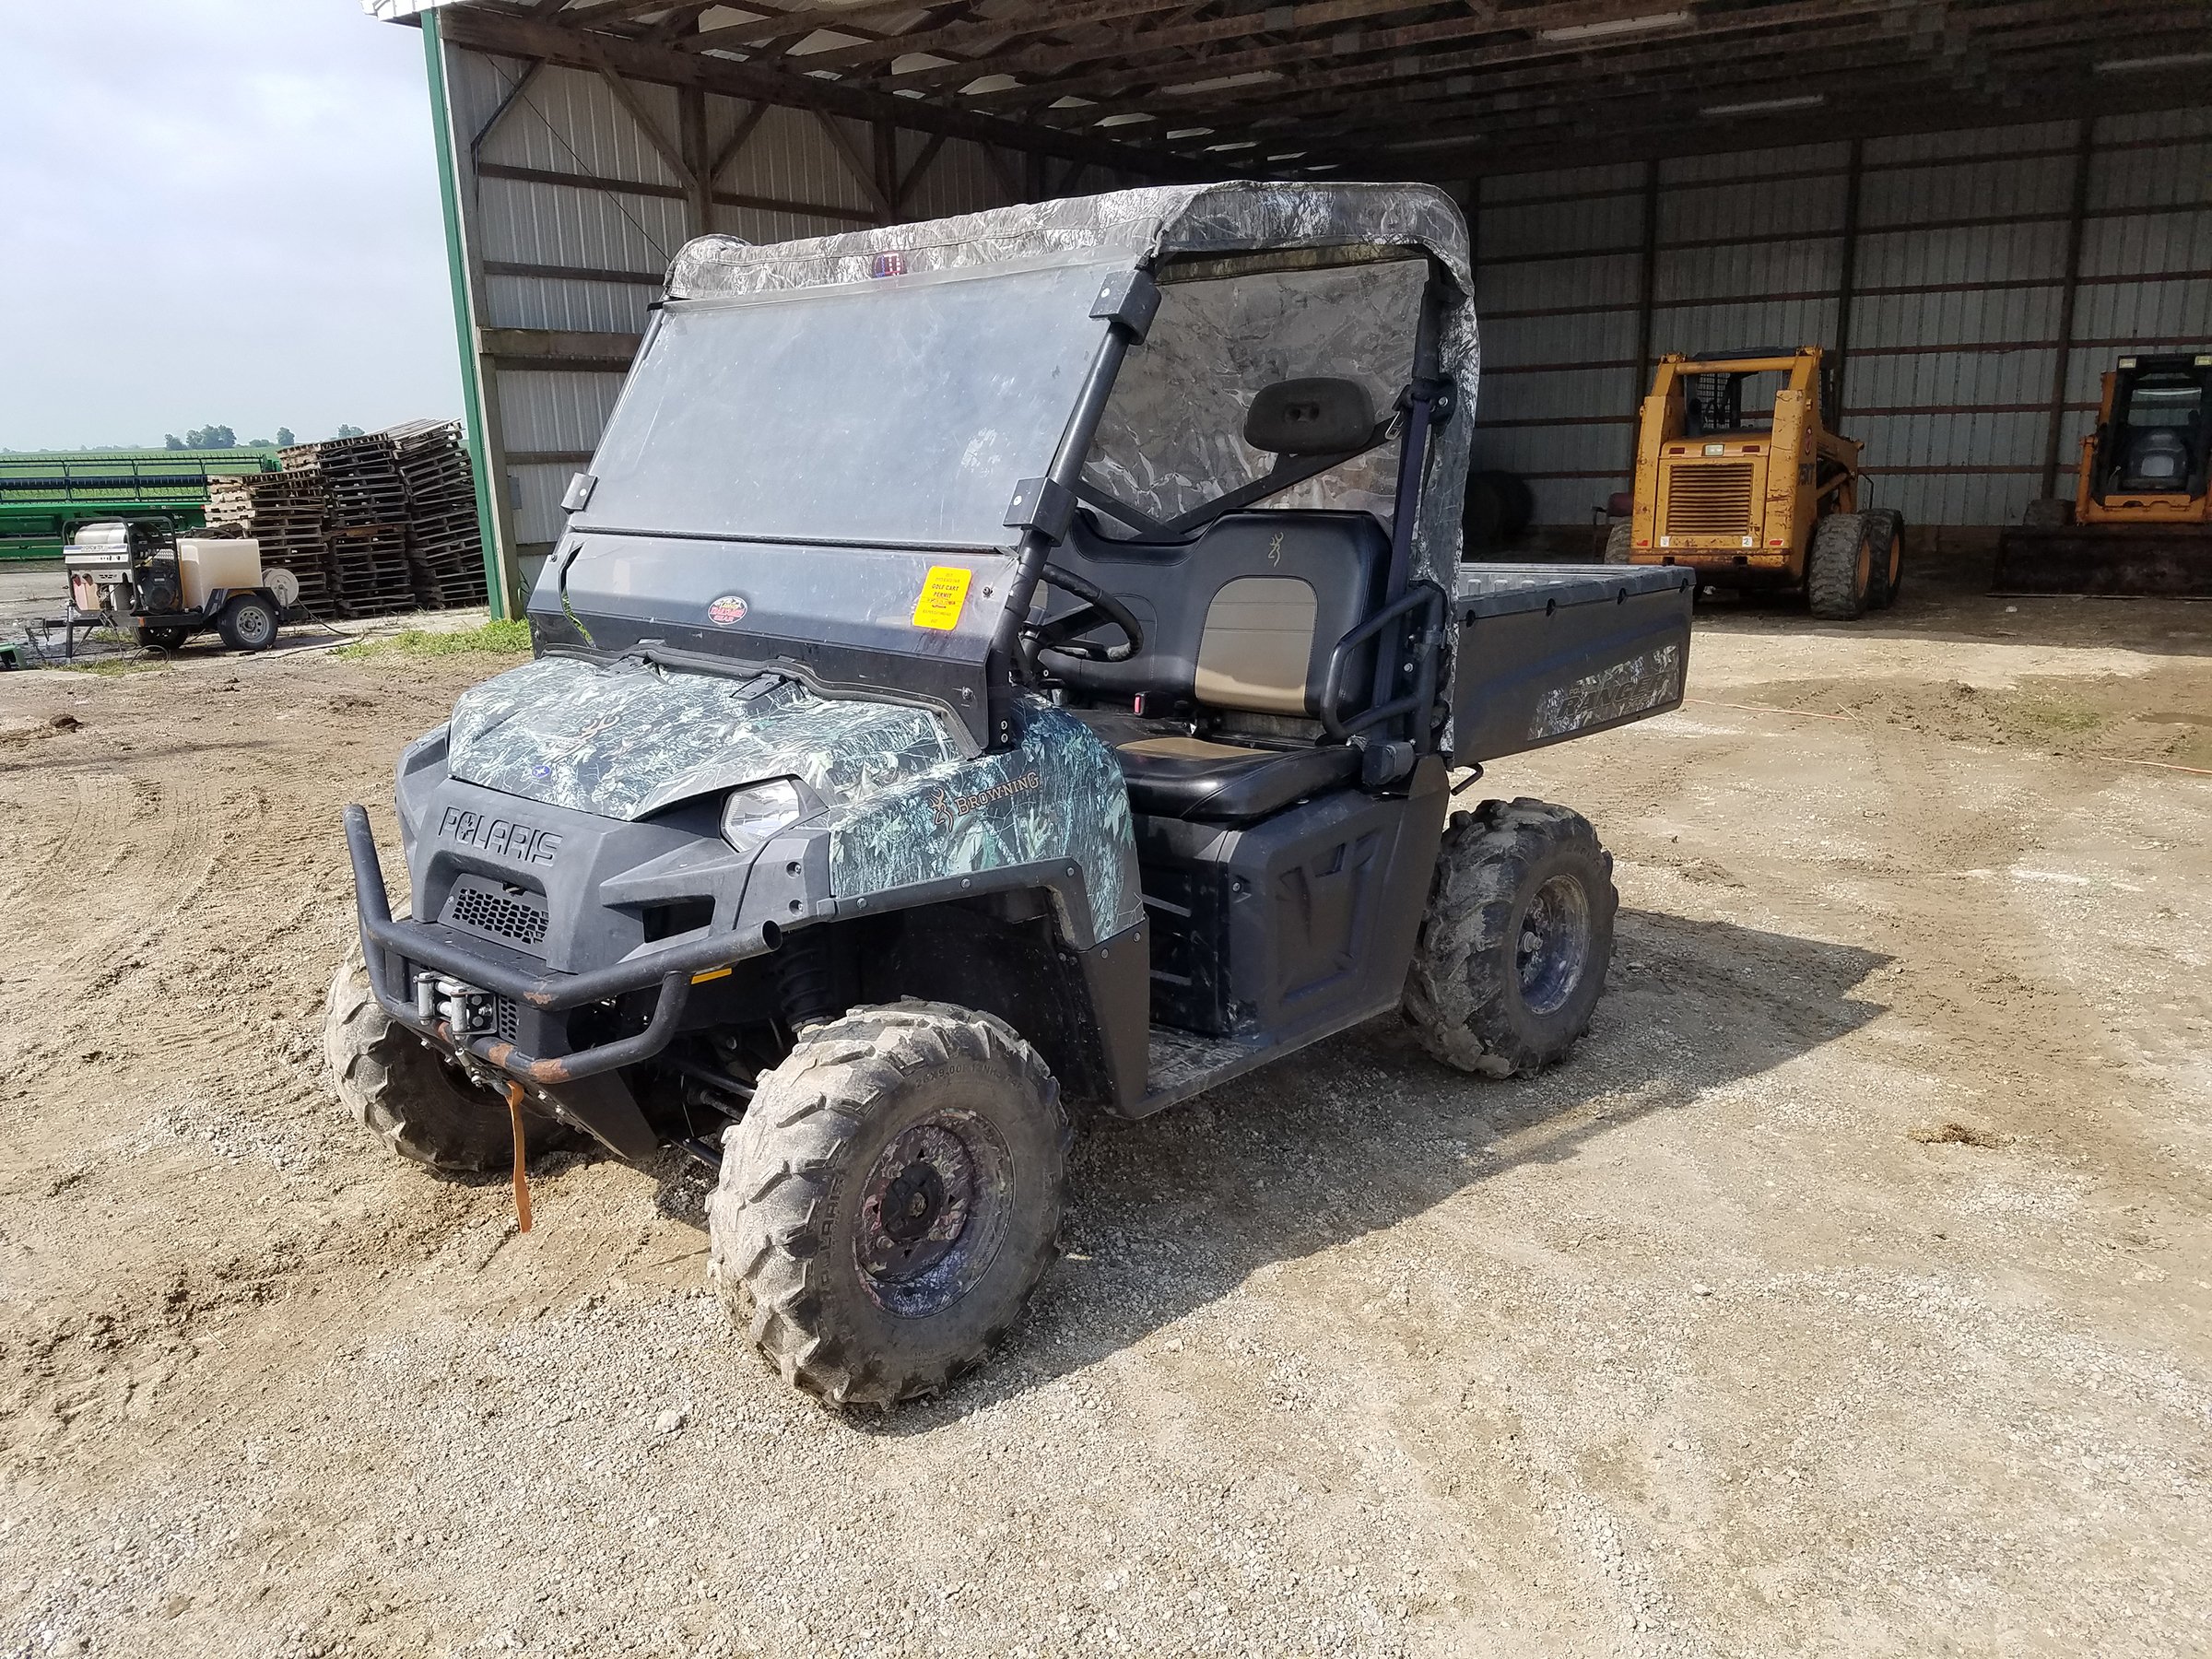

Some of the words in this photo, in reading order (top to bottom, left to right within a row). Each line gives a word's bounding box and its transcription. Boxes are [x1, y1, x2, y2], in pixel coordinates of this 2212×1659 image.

[931, 582, 946, 591] GOLF
[933, 591, 952, 599] PERMIT
[1555, 672, 1671, 720] RANGER
[954, 771, 1041, 817] BROWNING
[438, 806, 564, 867] POLARIS
